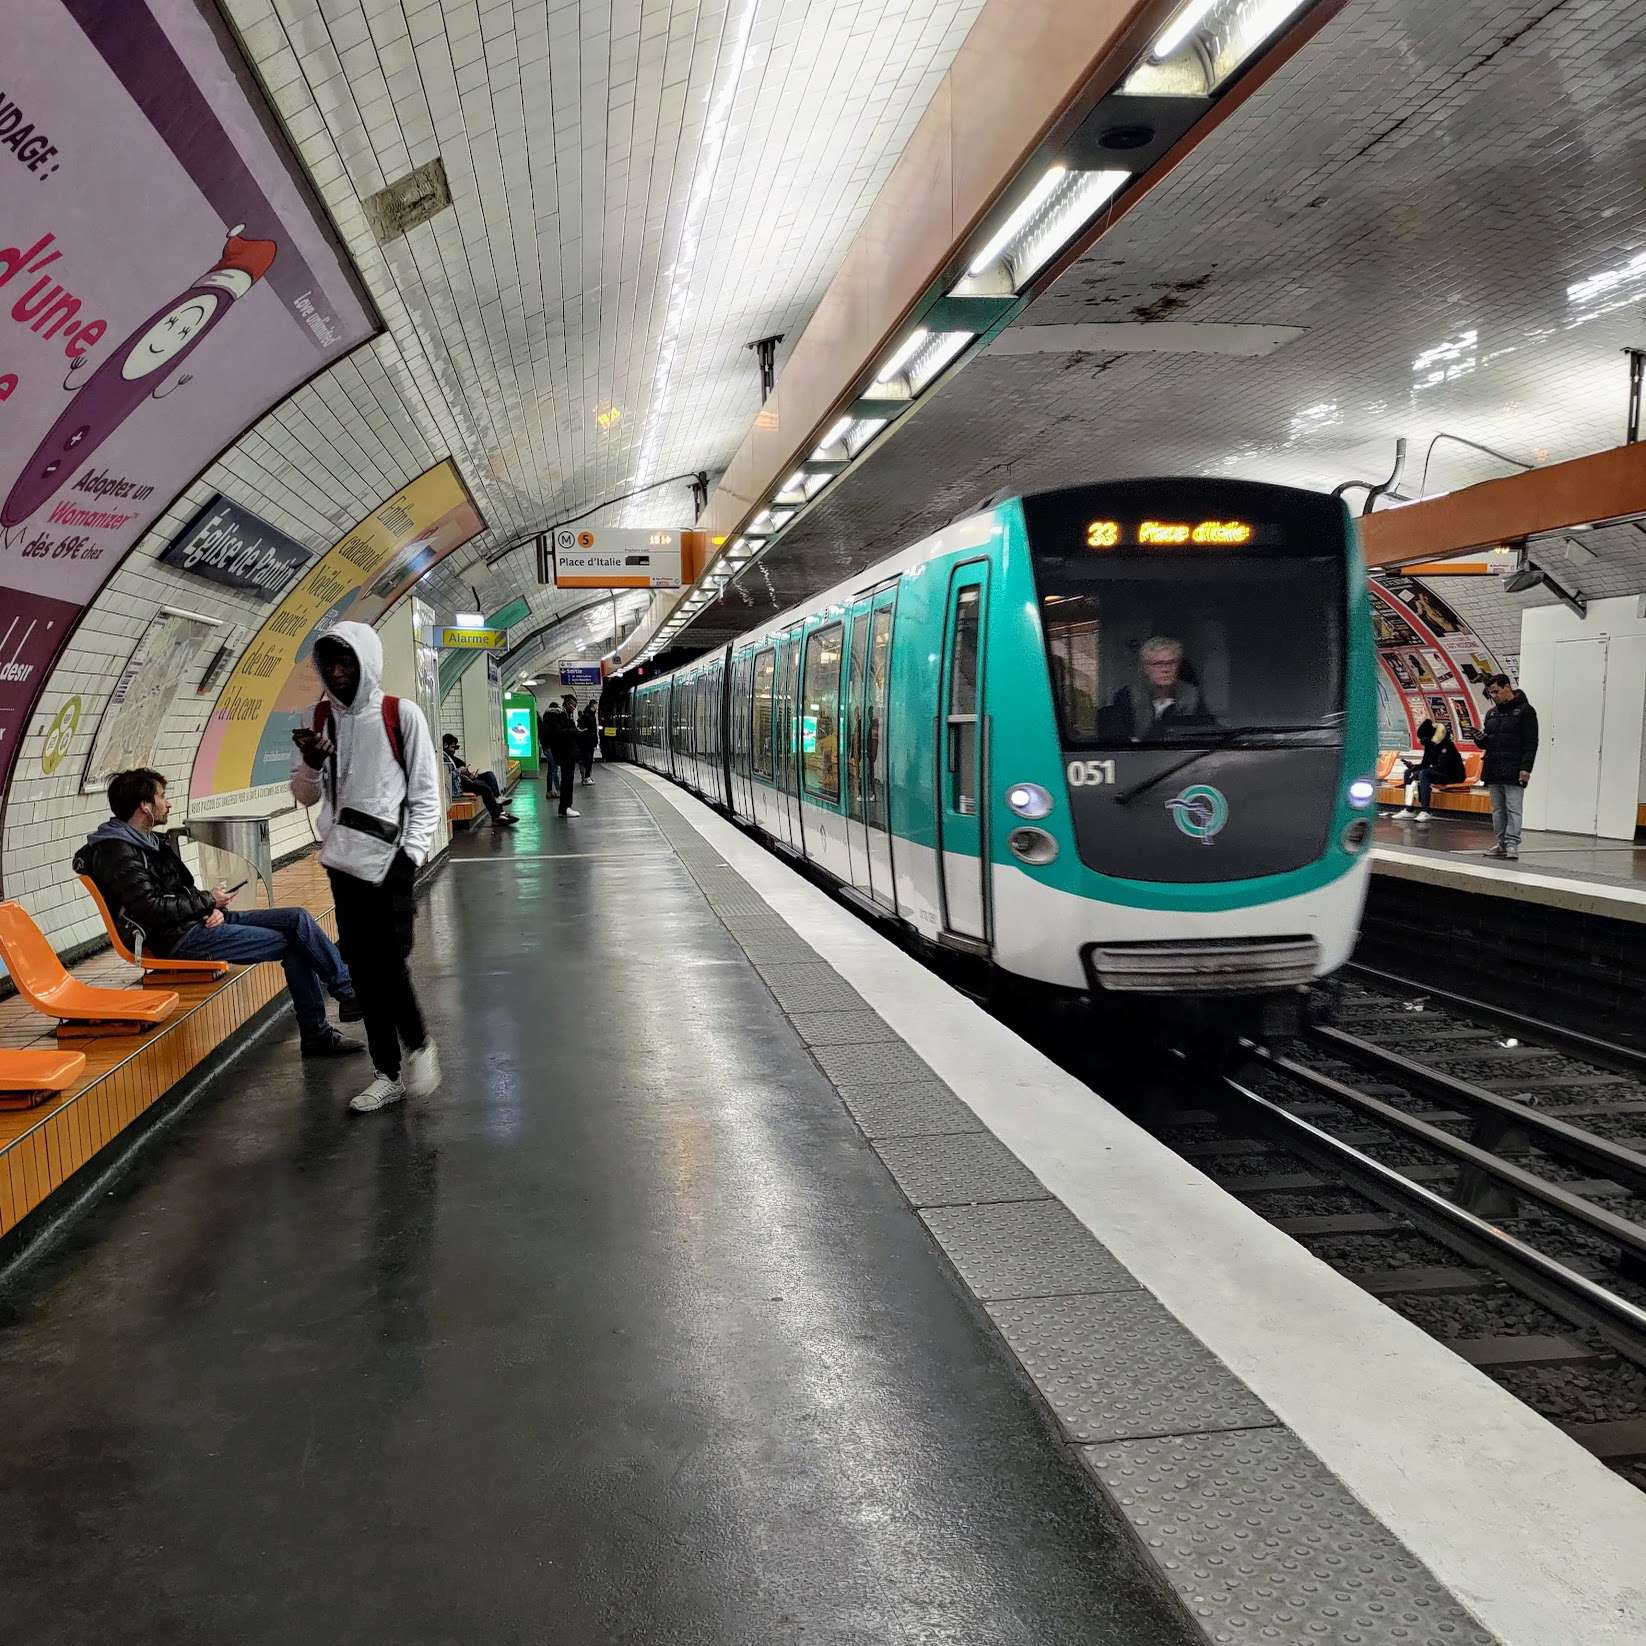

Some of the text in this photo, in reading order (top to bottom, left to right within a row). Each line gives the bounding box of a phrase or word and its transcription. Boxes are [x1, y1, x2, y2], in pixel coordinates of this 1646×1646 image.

[72, 468, 155, 501] Adoptez un
[21, 531, 104, 560] dès 69€ chez
[183, 507, 297, 592] Église de Pantin
[559, 557, 621, 567] Place d'Italie
[448, 632, 489, 644] Alarme
[1067, 759, 1115, 786] 051
